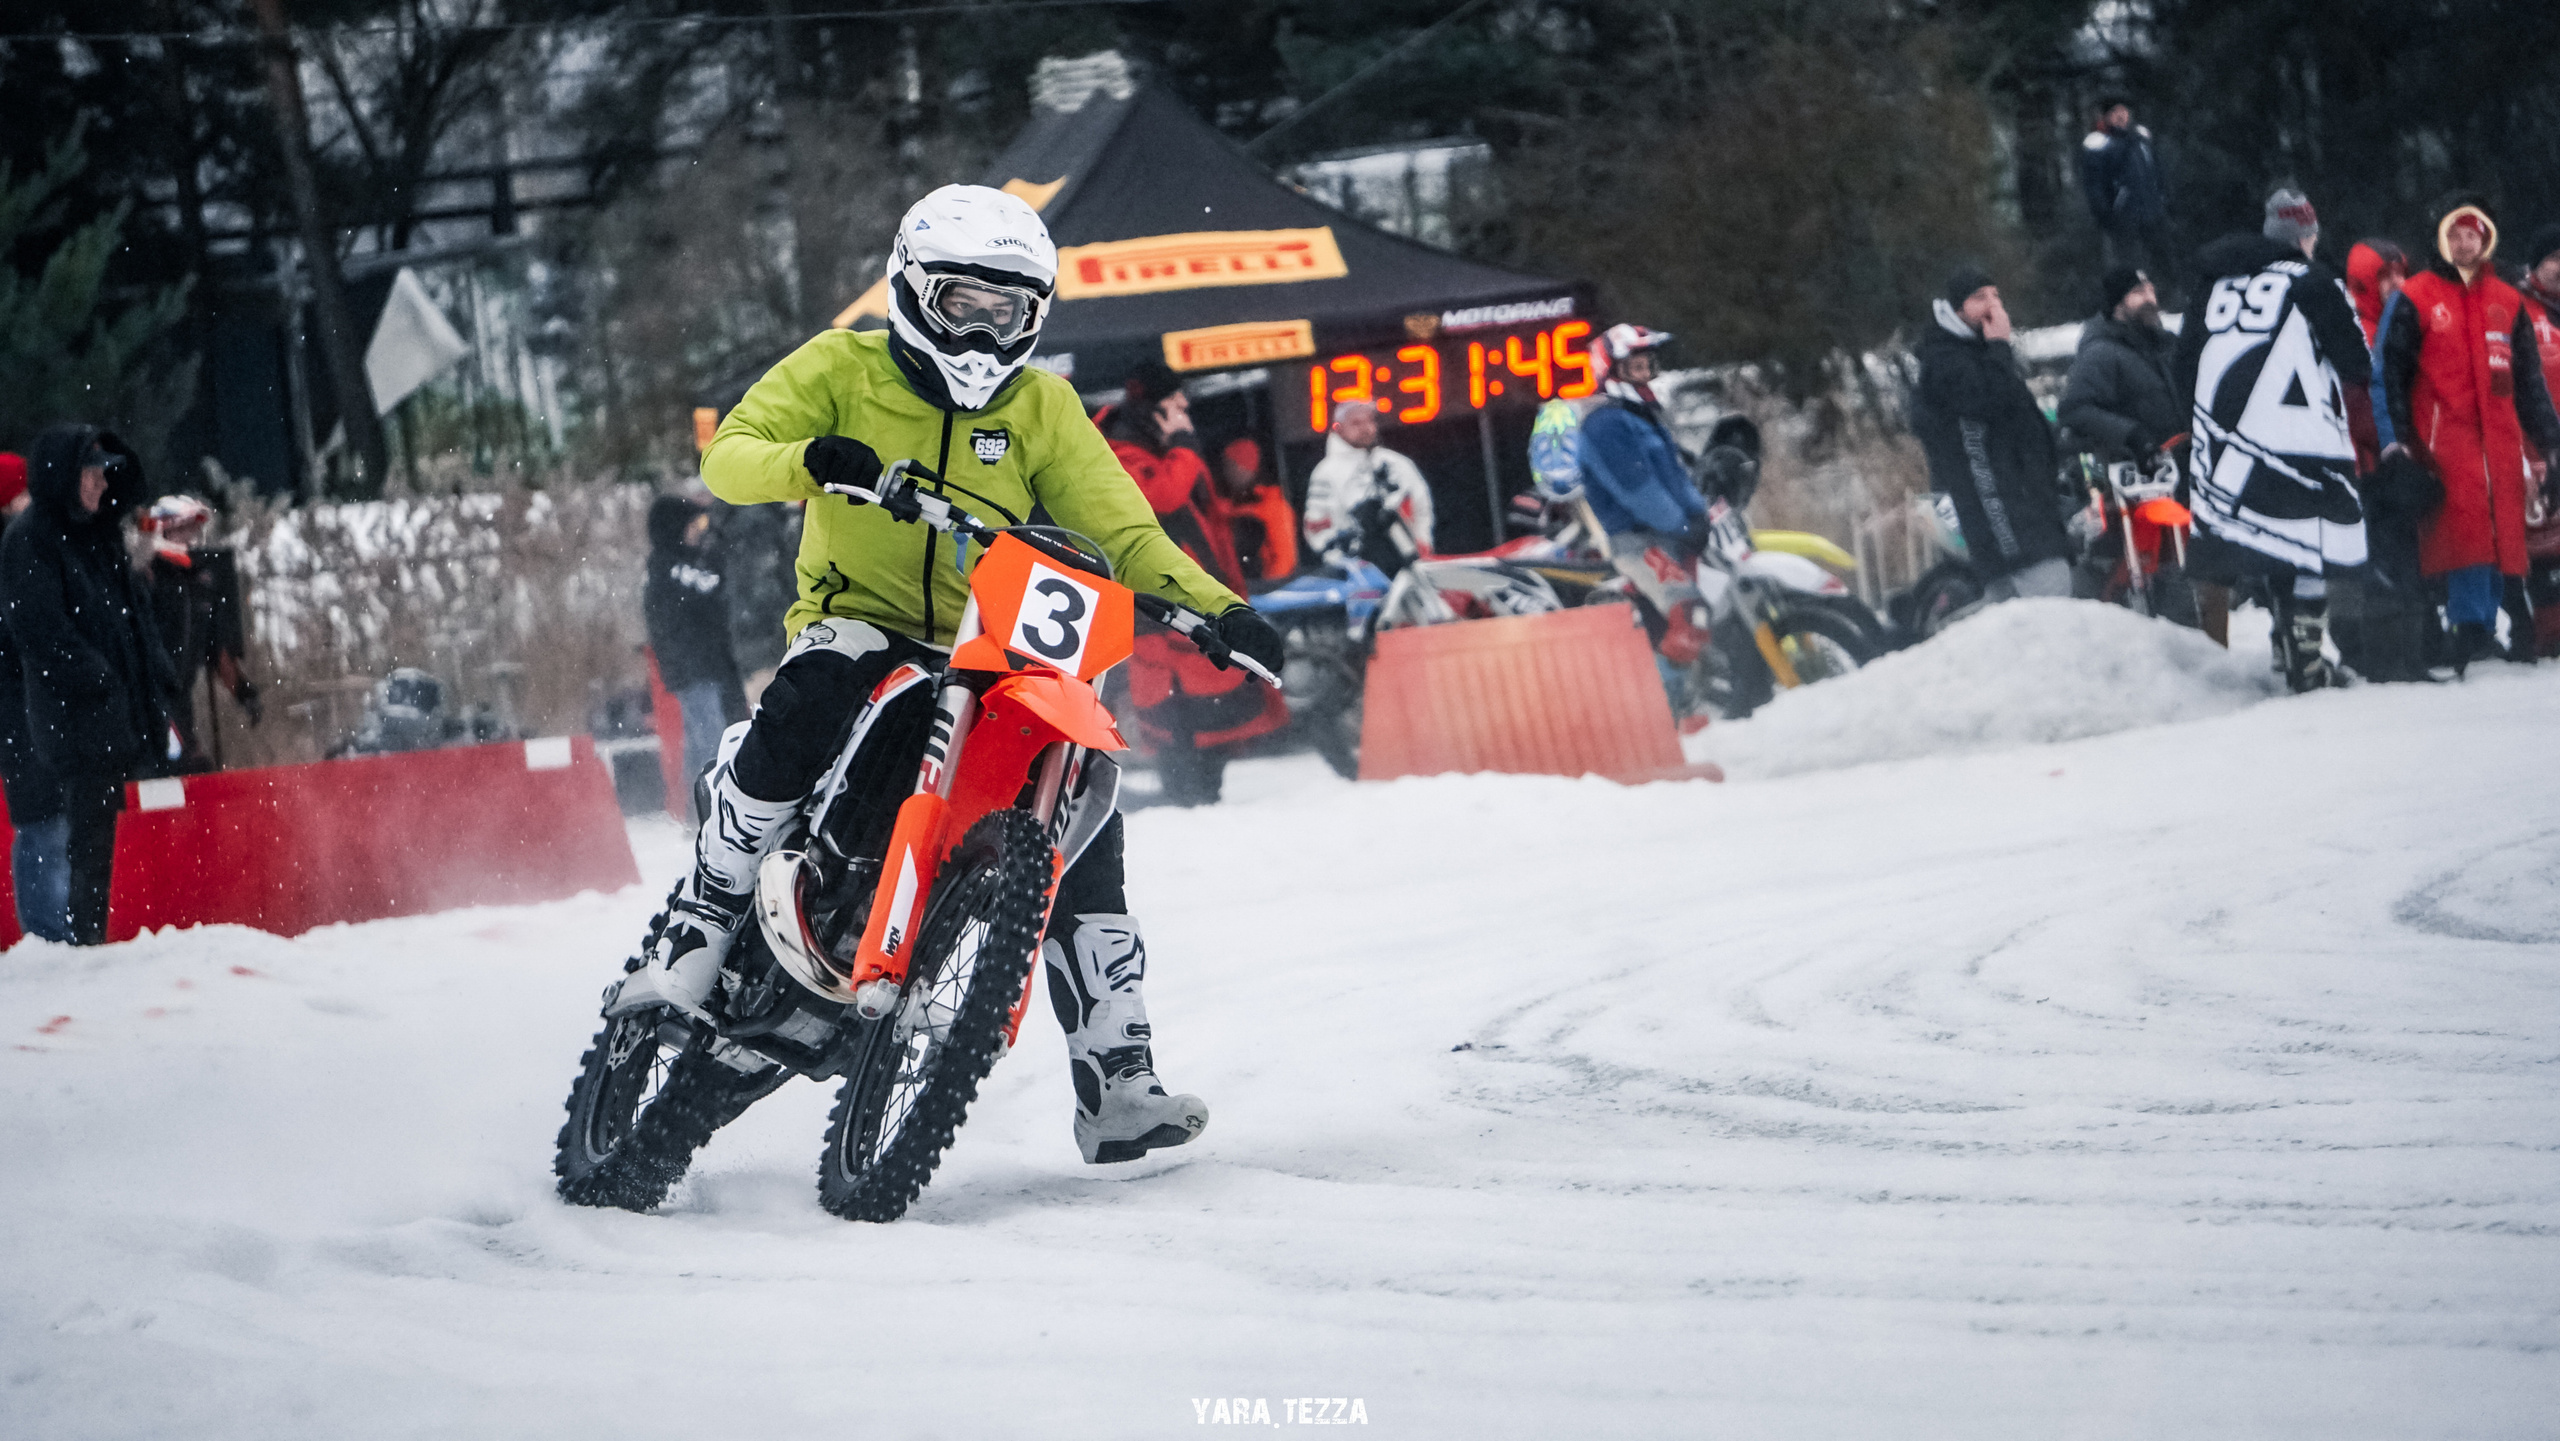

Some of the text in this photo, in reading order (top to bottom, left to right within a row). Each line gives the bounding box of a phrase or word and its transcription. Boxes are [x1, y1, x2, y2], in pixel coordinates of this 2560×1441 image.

[993, 238, 1034, 254] SHOEI
[1078, 242, 1313, 284] PIRELLI
[975, 438, 1007, 455] 692
[1030, 531, 1097, 564] READY TO RACE
[1022, 578, 1086, 660] 3
[885, 925, 901, 957] KTM
